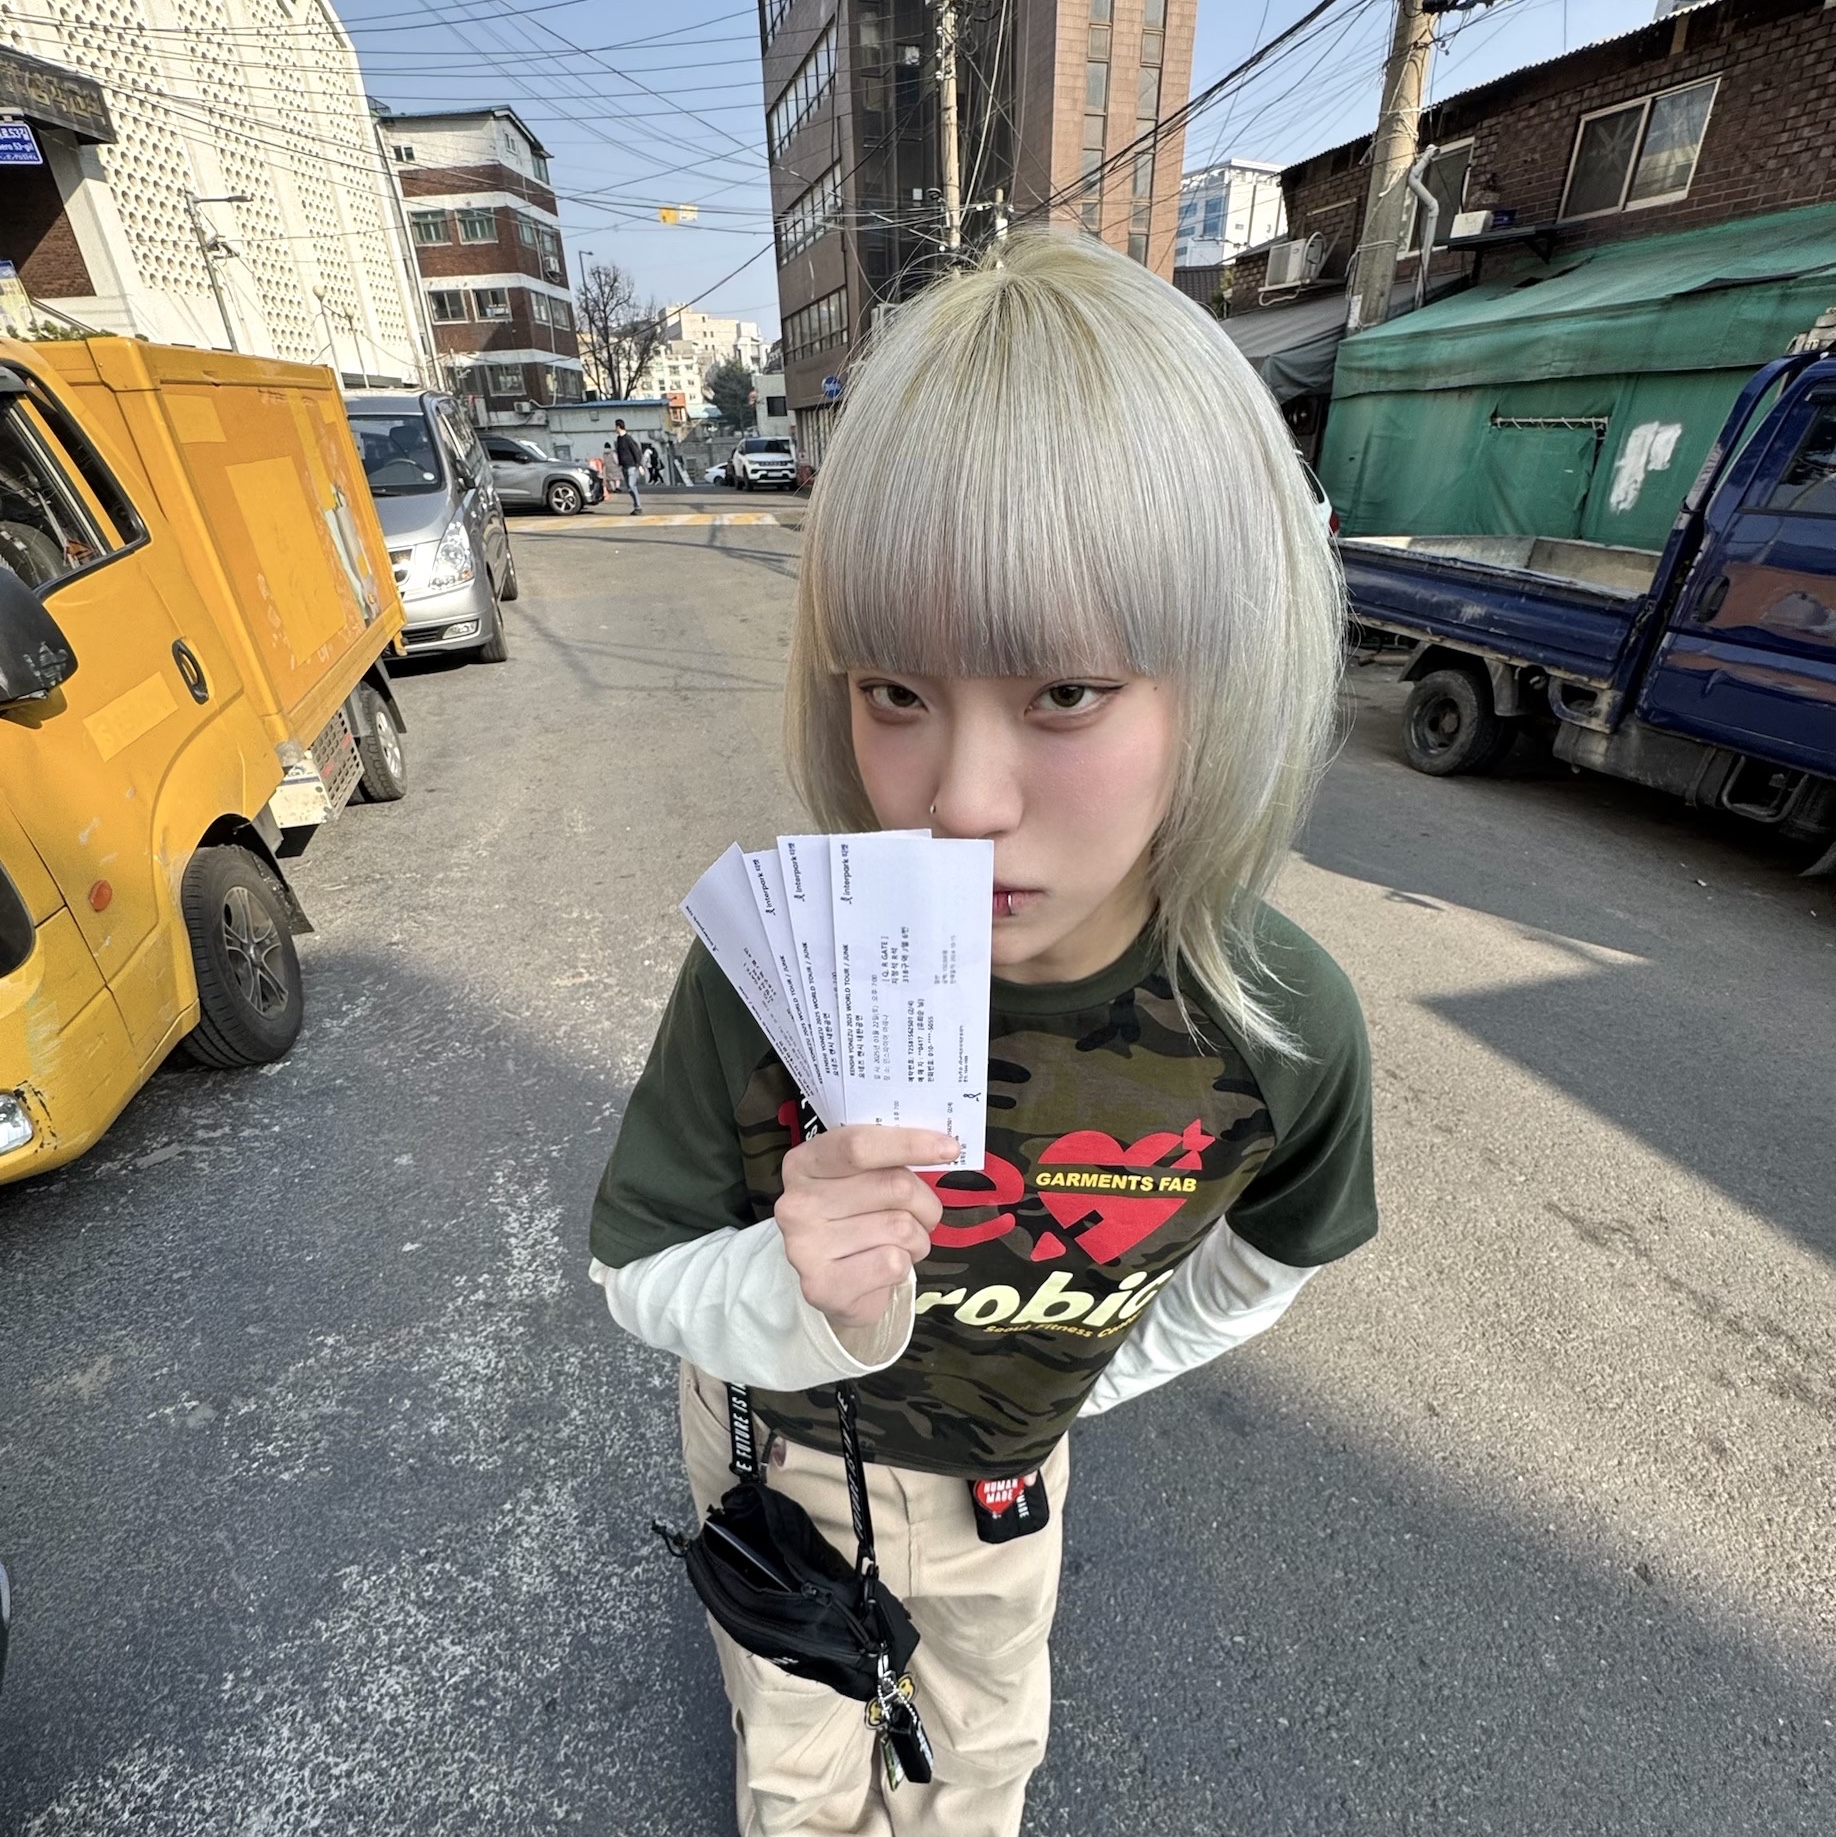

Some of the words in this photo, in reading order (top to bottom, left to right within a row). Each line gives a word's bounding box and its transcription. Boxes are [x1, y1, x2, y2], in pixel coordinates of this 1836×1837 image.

[0, 127, 30, 140] 로53길
[790, 855, 804, 893] interpark
[841, 858, 852, 895] interpark
[756, 871, 774, 908] interpark
[801, 941, 809, 959] JUNK
[880, 941, 888, 960] GATE
[806, 965, 814, 984] TOUR
[786, 978, 796, 996] TOUR
[809, 985, 818, 1009] WORLD
[792, 997, 804, 1021] WORLD
[855, 1014, 864, 1041] 내한공연
[846, 1028, 854, 1053] YONEZU
[857, 1059, 865, 1078] 요네즈
[1035, 1172, 1154, 1192] GARMENTS
[1158, 1177, 1197, 1193] FAB
[983, 1324, 1032, 1333] Seoul
[1035, 1323, 1094, 1338] Fitness
[731, 1397, 748, 1413] IS
[733, 1413, 752, 1460] FUTURE
[984, 1478, 1018, 1493] HUMAN
[986, 1489, 1013, 1504] MADE
